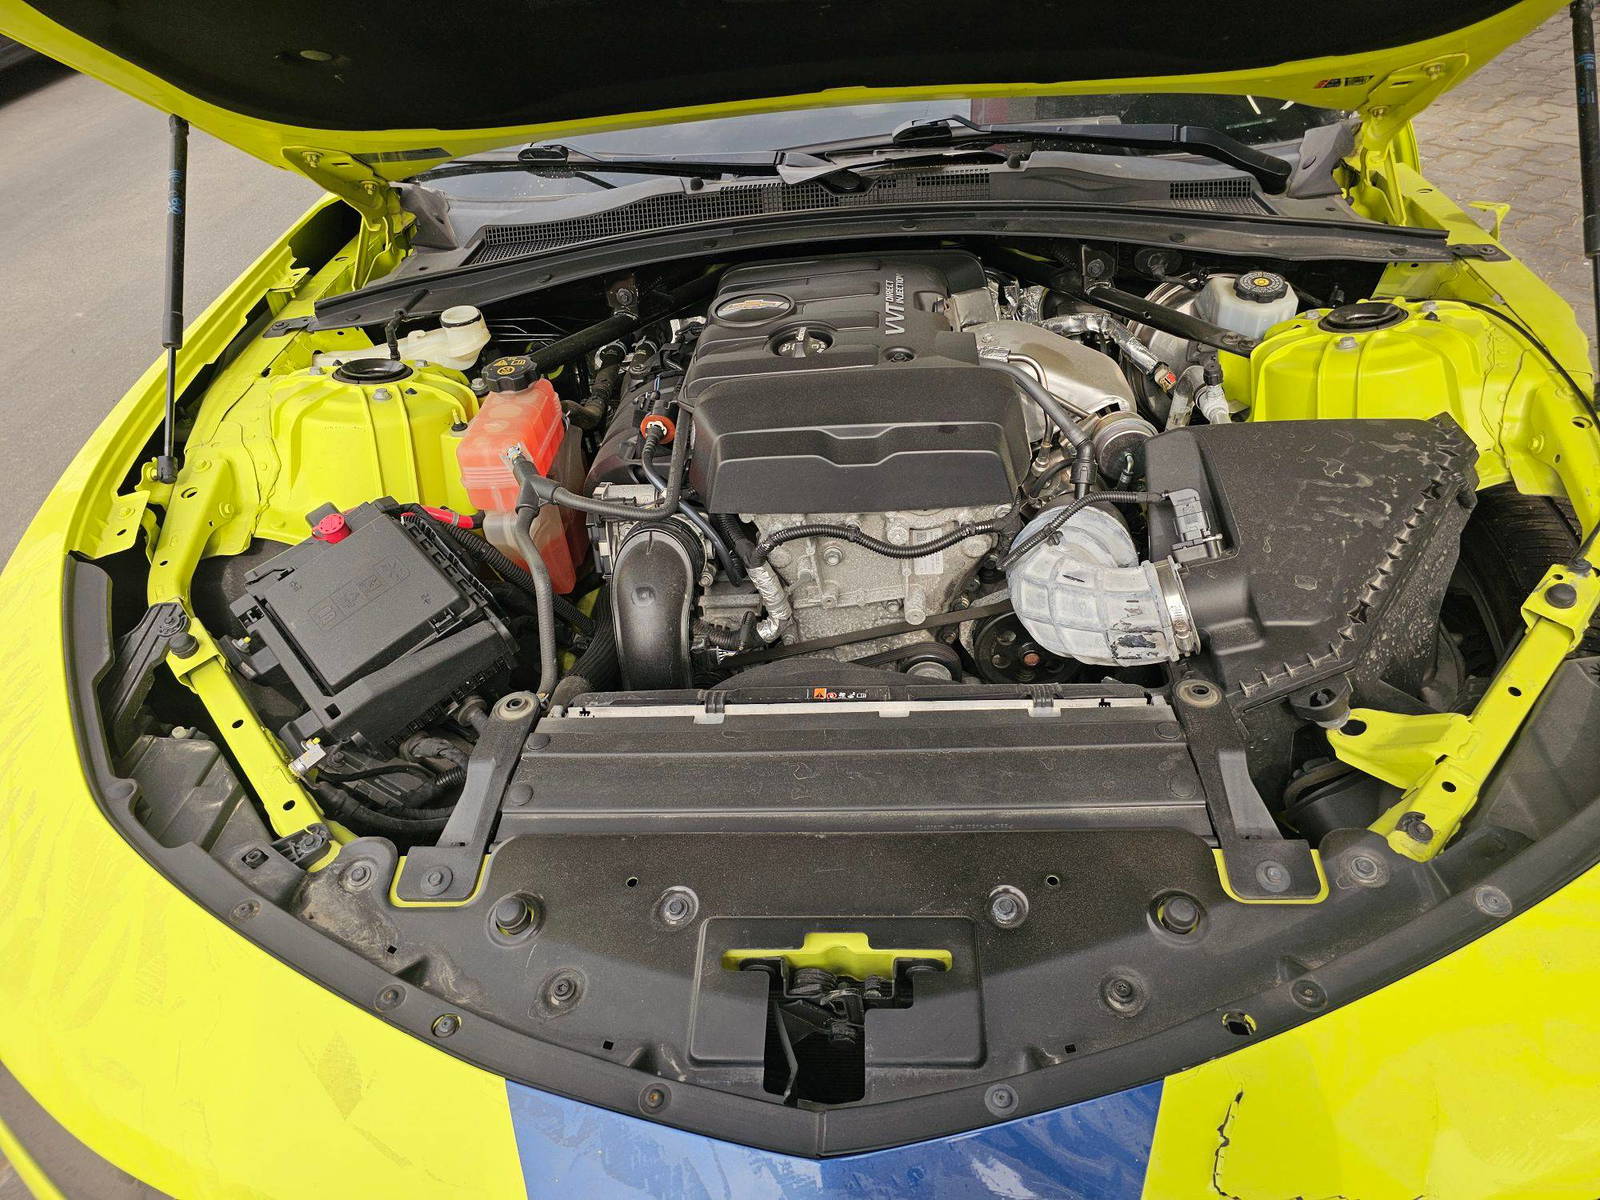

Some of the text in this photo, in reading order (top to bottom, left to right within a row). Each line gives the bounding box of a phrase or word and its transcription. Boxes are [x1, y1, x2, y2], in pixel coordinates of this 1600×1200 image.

[885, 279, 894, 302] DIRECT
[895, 272, 904, 304] INJECTION
[885, 302, 905, 335] VVT
